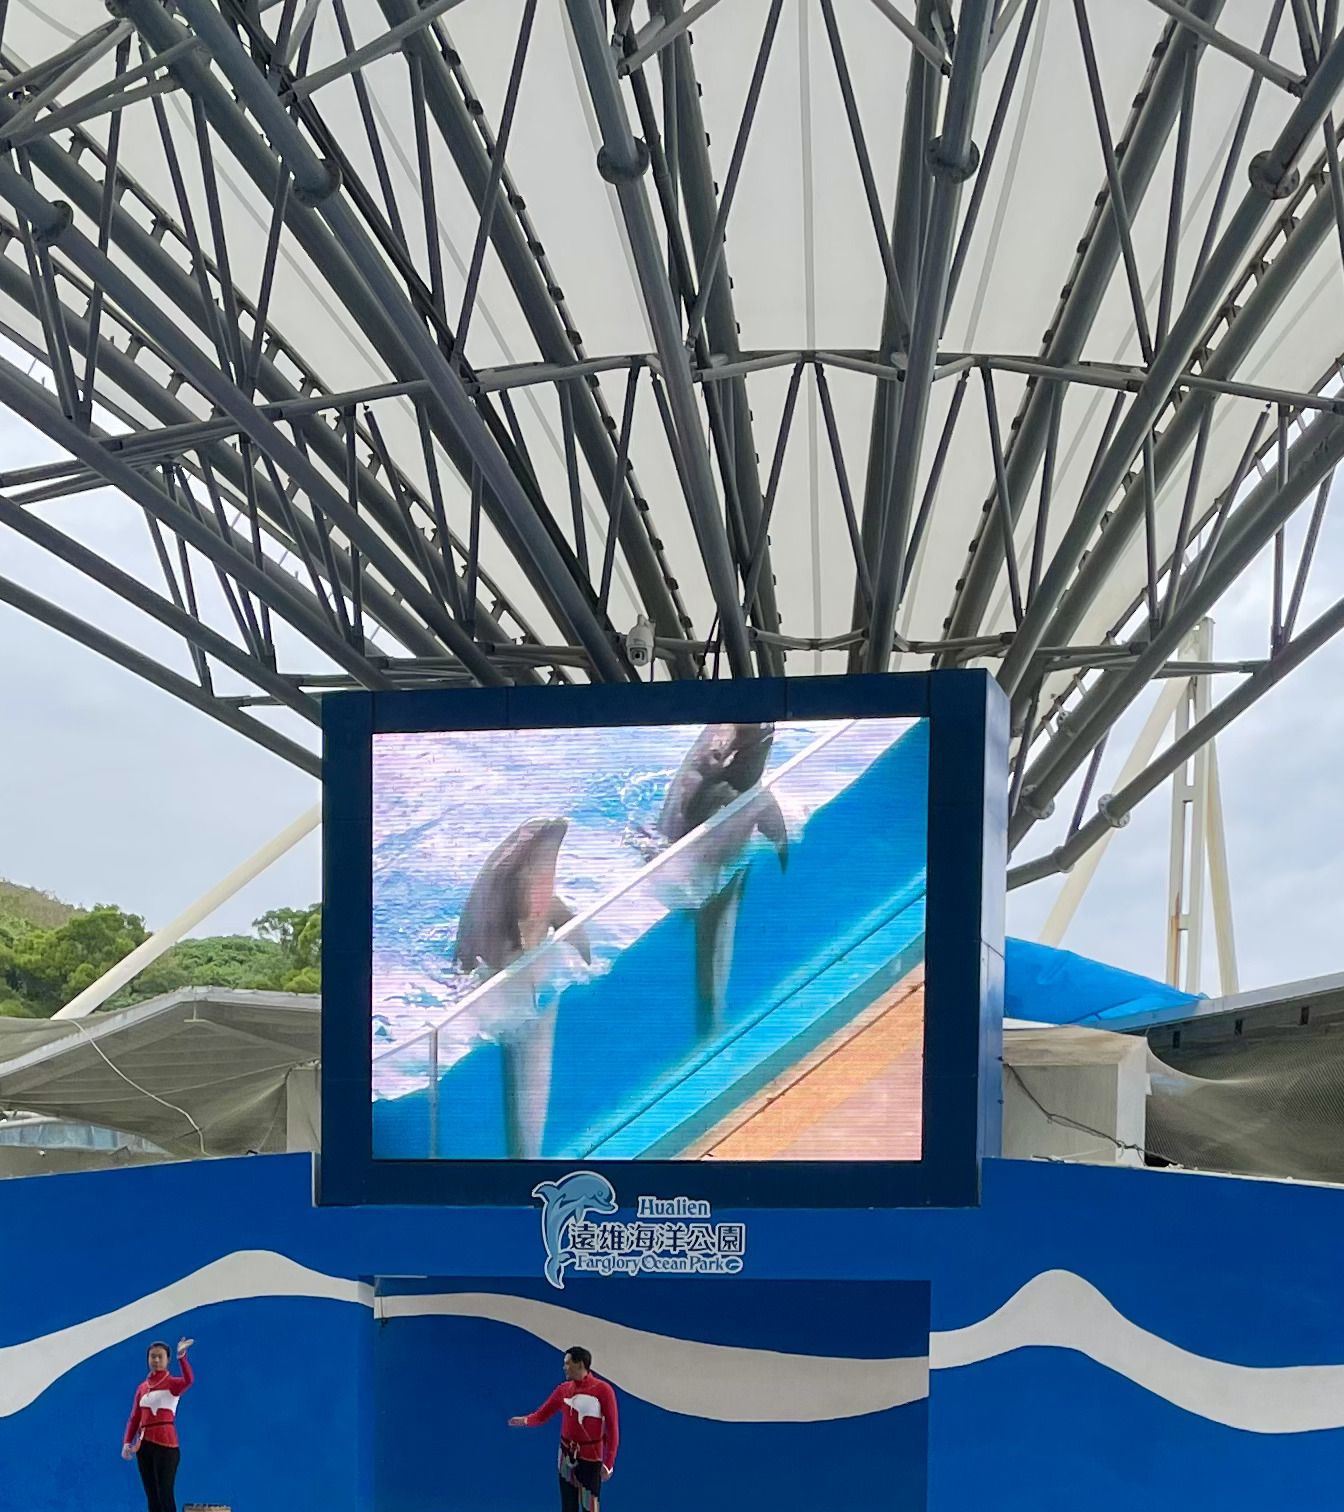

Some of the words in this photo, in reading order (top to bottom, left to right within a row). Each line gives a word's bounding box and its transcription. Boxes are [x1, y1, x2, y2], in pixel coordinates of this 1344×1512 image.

[639, 1198, 709, 1216] Hualien
[570, 1224, 743, 1252] 遠雄海洋公園
[577, 1255, 641, 1275] Farglory
[642, 1256, 687, 1271] Ocean
[689, 1255, 724, 1271] Park
